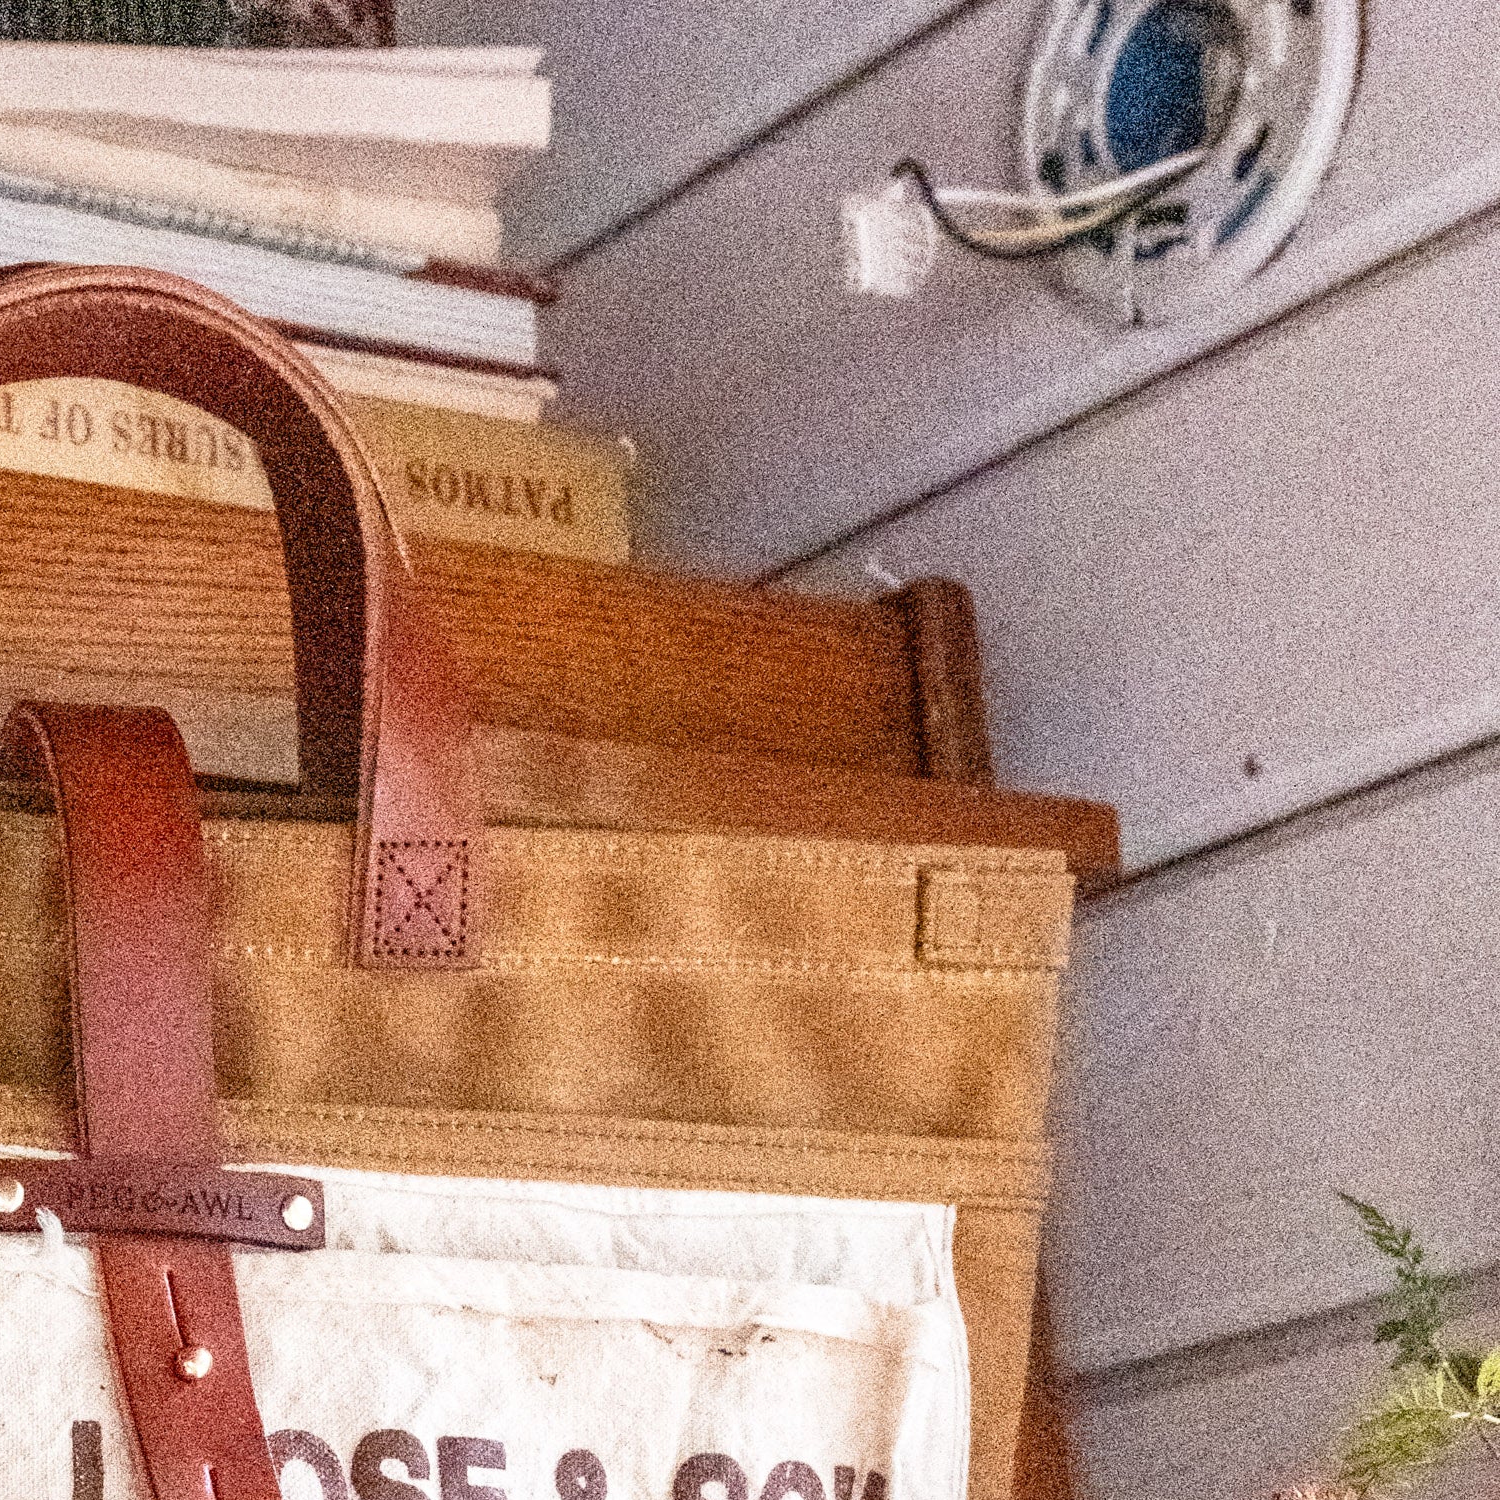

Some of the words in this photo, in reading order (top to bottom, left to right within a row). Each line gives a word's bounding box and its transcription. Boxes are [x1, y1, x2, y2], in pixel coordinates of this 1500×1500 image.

[39, 397, 92, 446] OF
[408, 458, 576, 527] PATMOS
[179, 1188, 254, 1222] AWL
